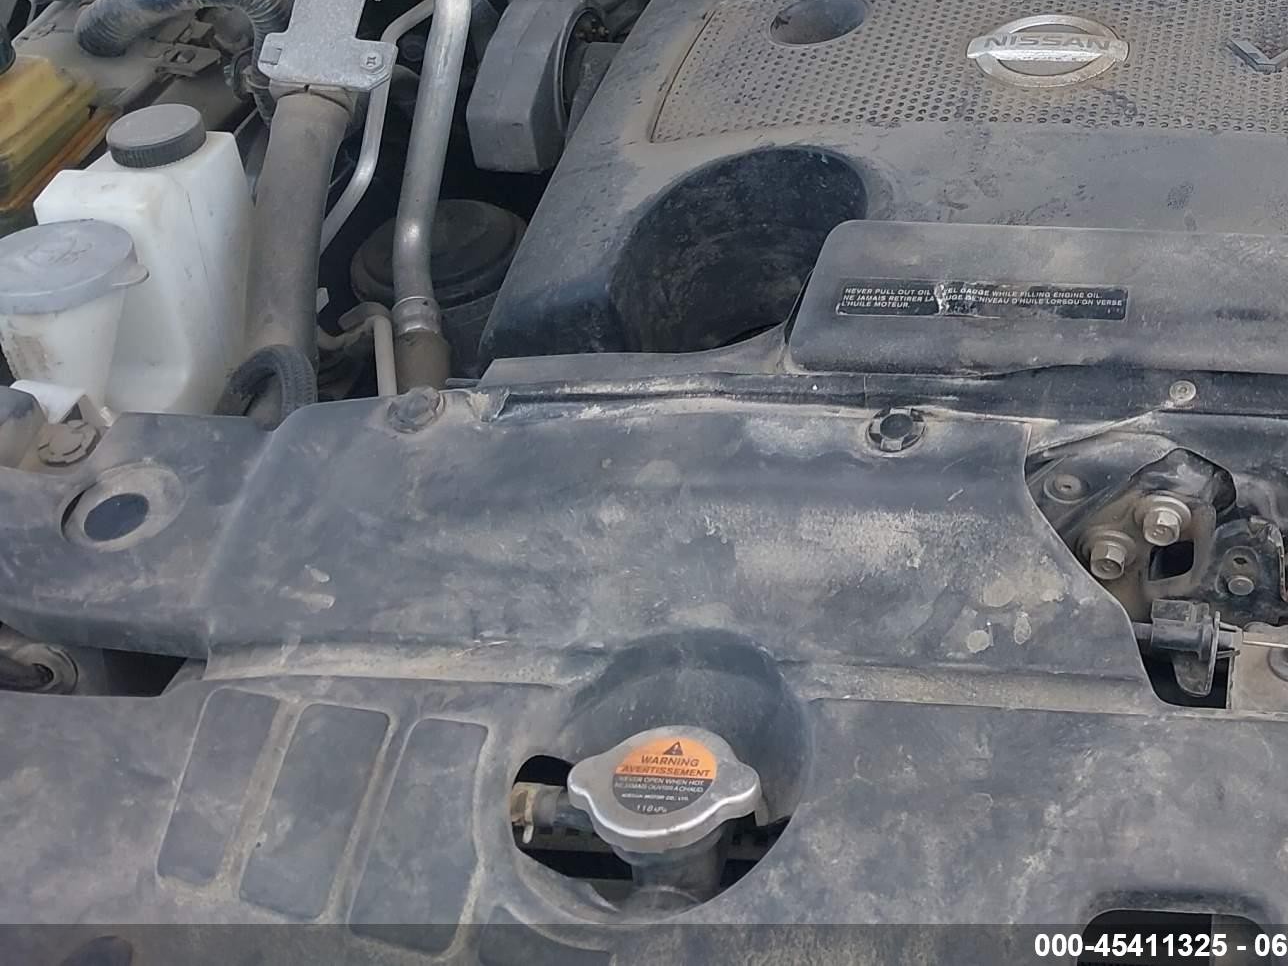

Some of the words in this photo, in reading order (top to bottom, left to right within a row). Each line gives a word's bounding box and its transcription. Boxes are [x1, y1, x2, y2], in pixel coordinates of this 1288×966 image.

[984, 35, 1110, 50] NISSAN
[1053, 291, 1085, 299] ENGINE
[979, 296, 1010, 304] NIVEAU
[1011, 297, 1045, 305] D'HUILE
[641, 755, 700, 767] WARNING
[622, 765, 711, 777] AVERTISSEMENT
[643, 776, 664, 784] OPEN
